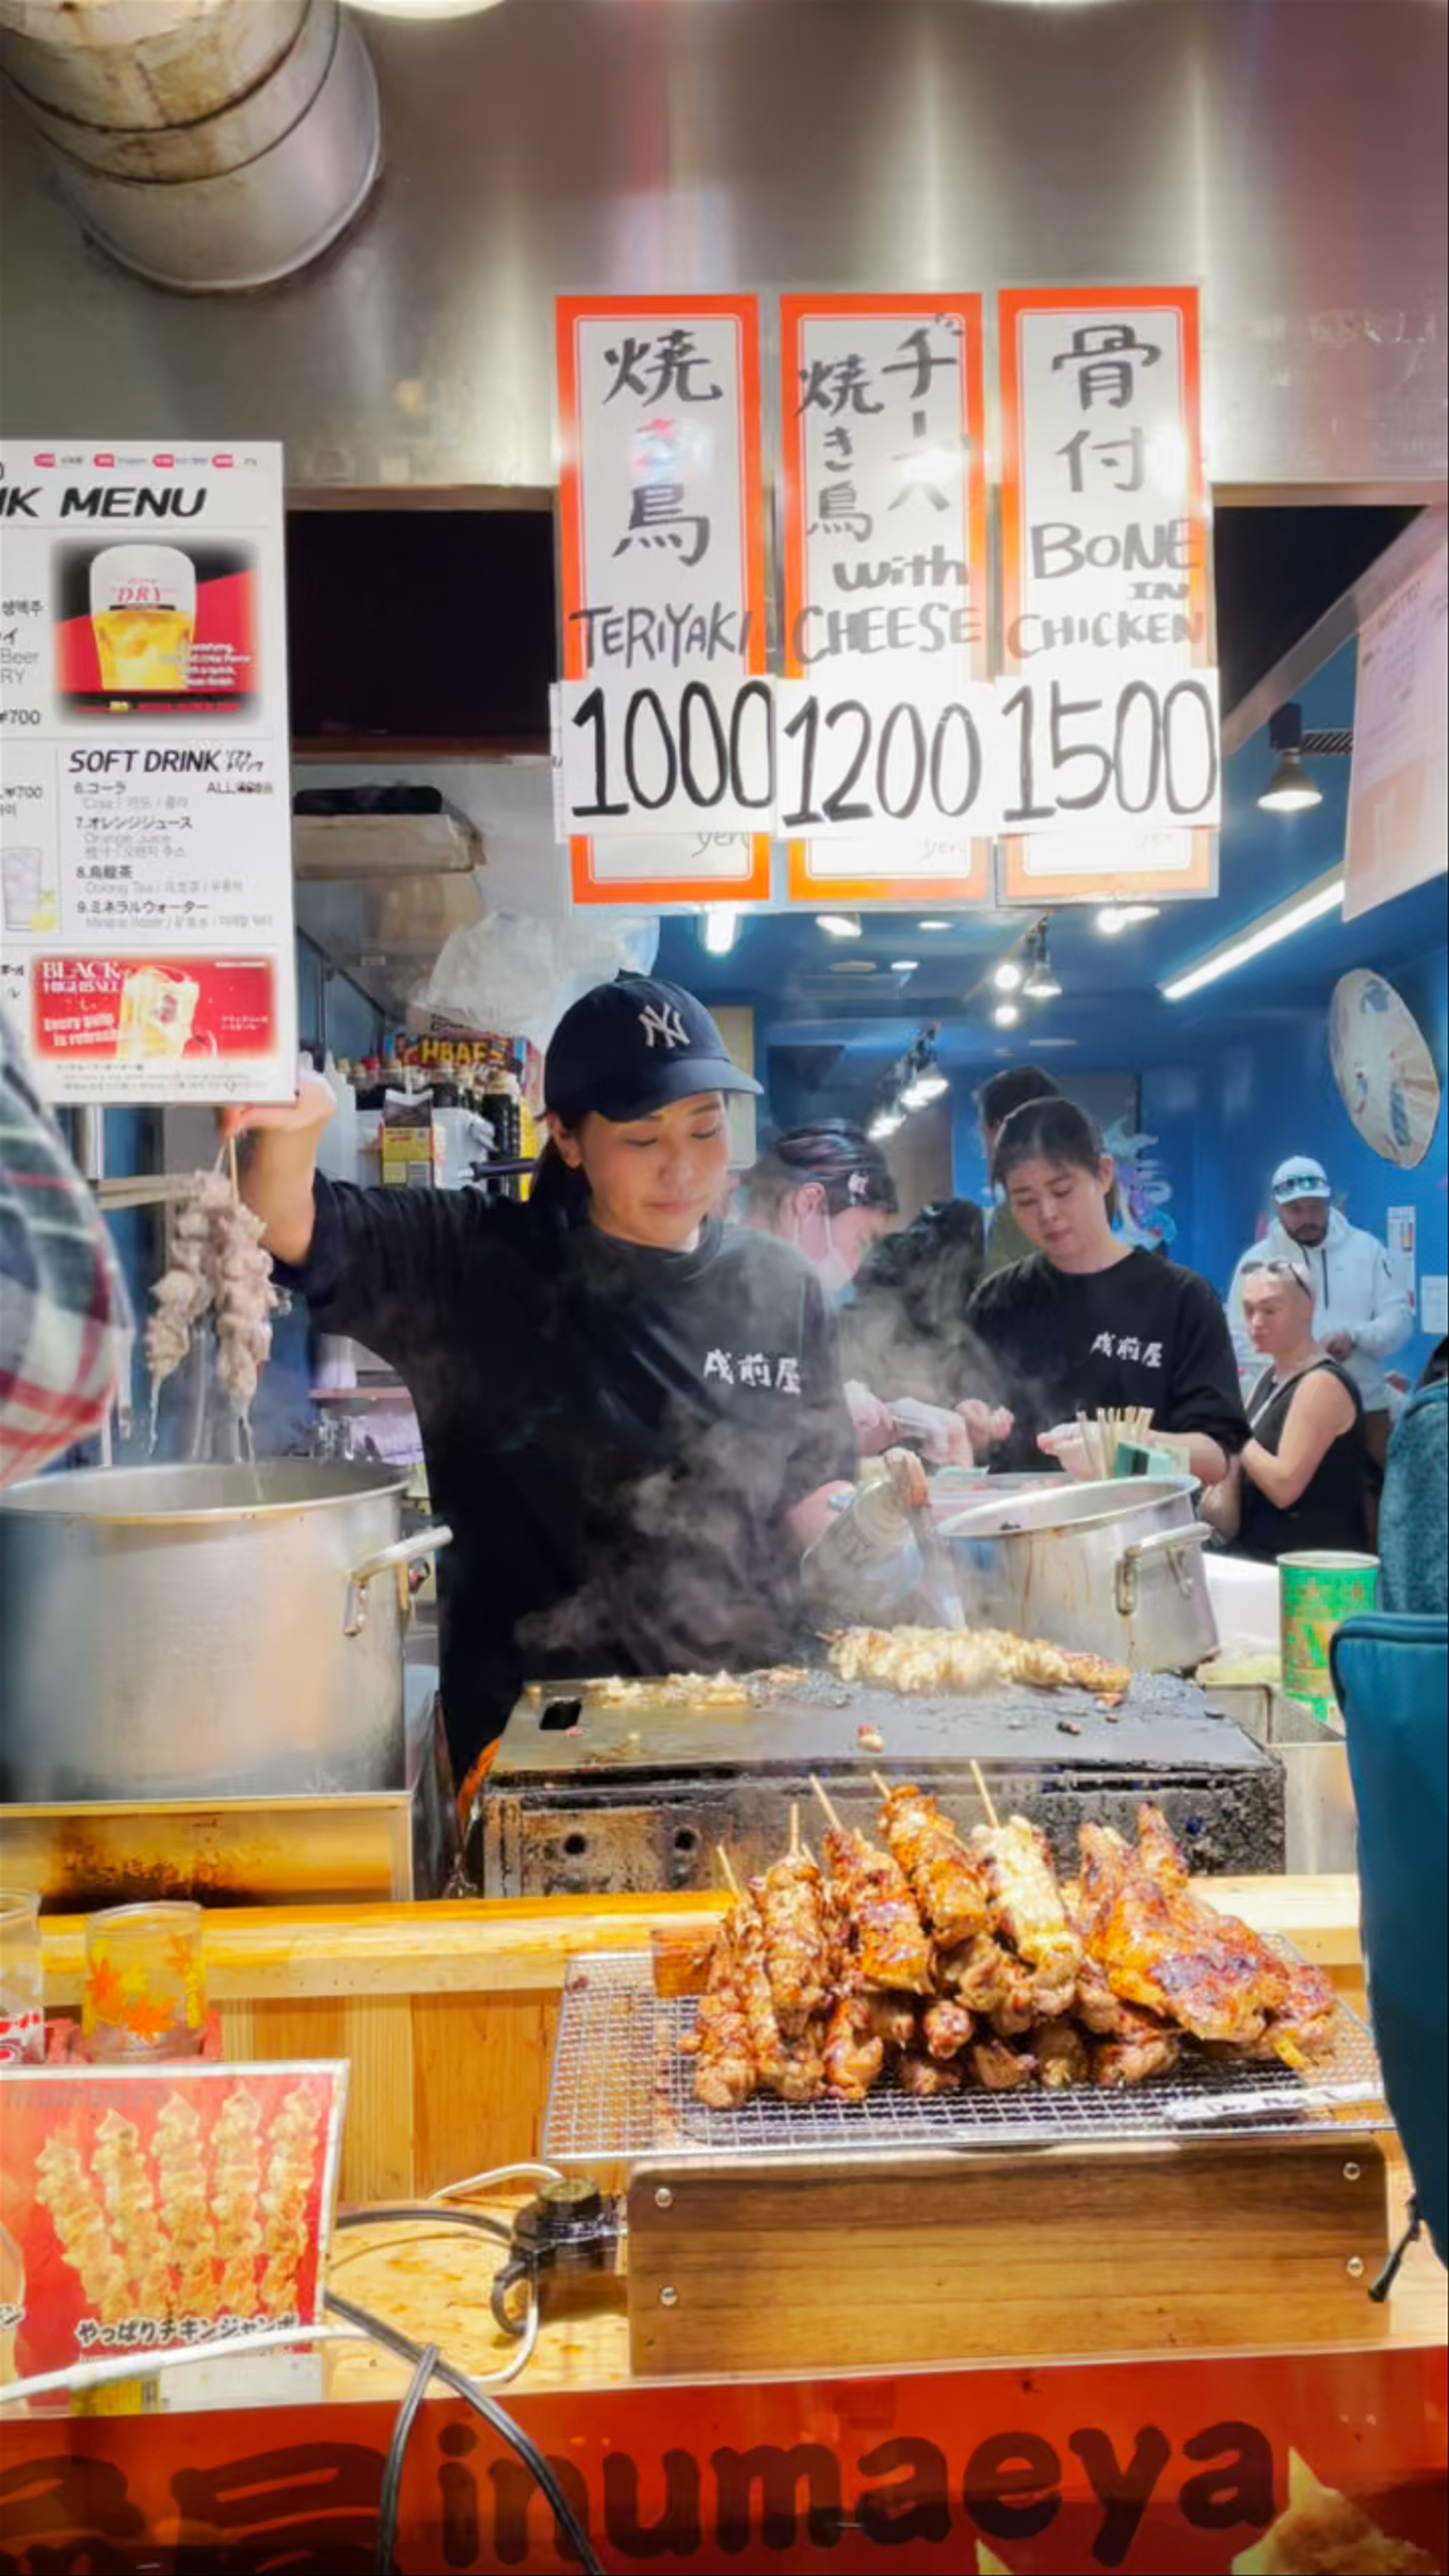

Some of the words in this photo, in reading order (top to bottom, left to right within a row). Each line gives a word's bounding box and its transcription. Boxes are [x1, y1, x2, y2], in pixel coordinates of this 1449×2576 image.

[1053, 323, 1161, 493] 骨付
[794, 353, 885, 543] 焼き鳥
[0, 488, 42, 517] K
[60, 488, 207, 517] MENU
[832, 545, 969, 592] with
[1031, 518, 1204, 580] BONE
[1126, 580, 1191, 600] IN
[568, 601, 752, 669] TERIYAKI
[793, 601, 982, 664] CHEESE
[1007, 611, 1204, 660] CHICKEN
[69, 749, 138, 772] SOFT
[144, 749, 220, 772] DRINK
[572, 678, 775, 817] 1000
[783, 695, 982, 827] 1200
[1001, 679, 1217, 821] 1500
[43, 961, 121, 979] BLACK
[638, 1003, 690, 1048] NY
[437, 2420, 1276, 2569] inumaeya
